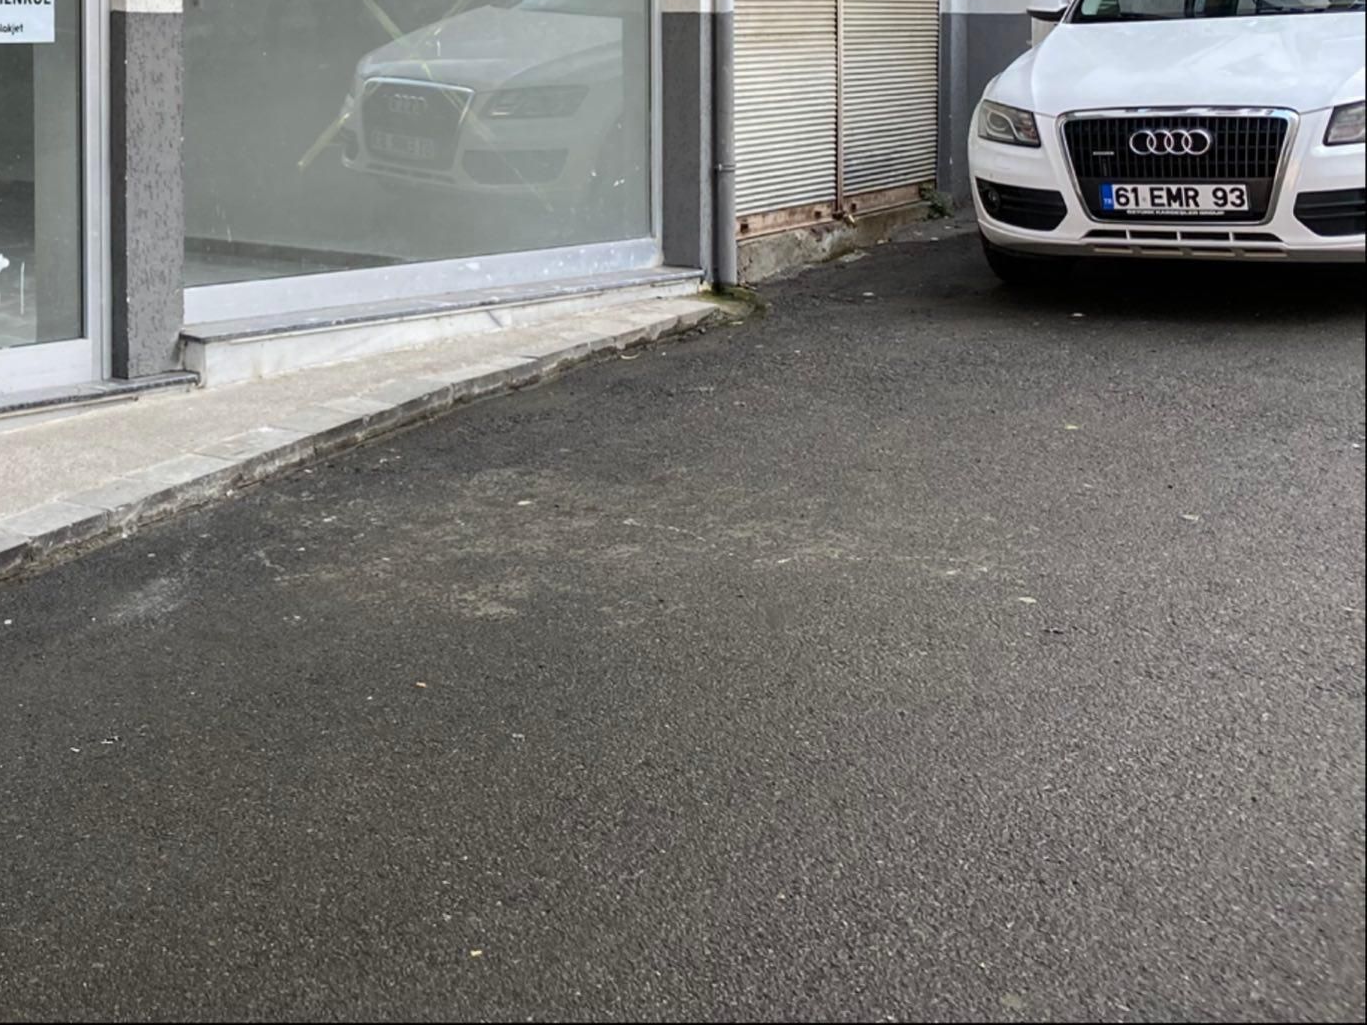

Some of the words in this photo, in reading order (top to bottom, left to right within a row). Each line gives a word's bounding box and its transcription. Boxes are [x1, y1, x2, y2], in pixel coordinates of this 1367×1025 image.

[1114, 187, 1140, 208] 61
[1149, 187, 1200, 208] EMR
[1211, 187, 1246, 208] 93
